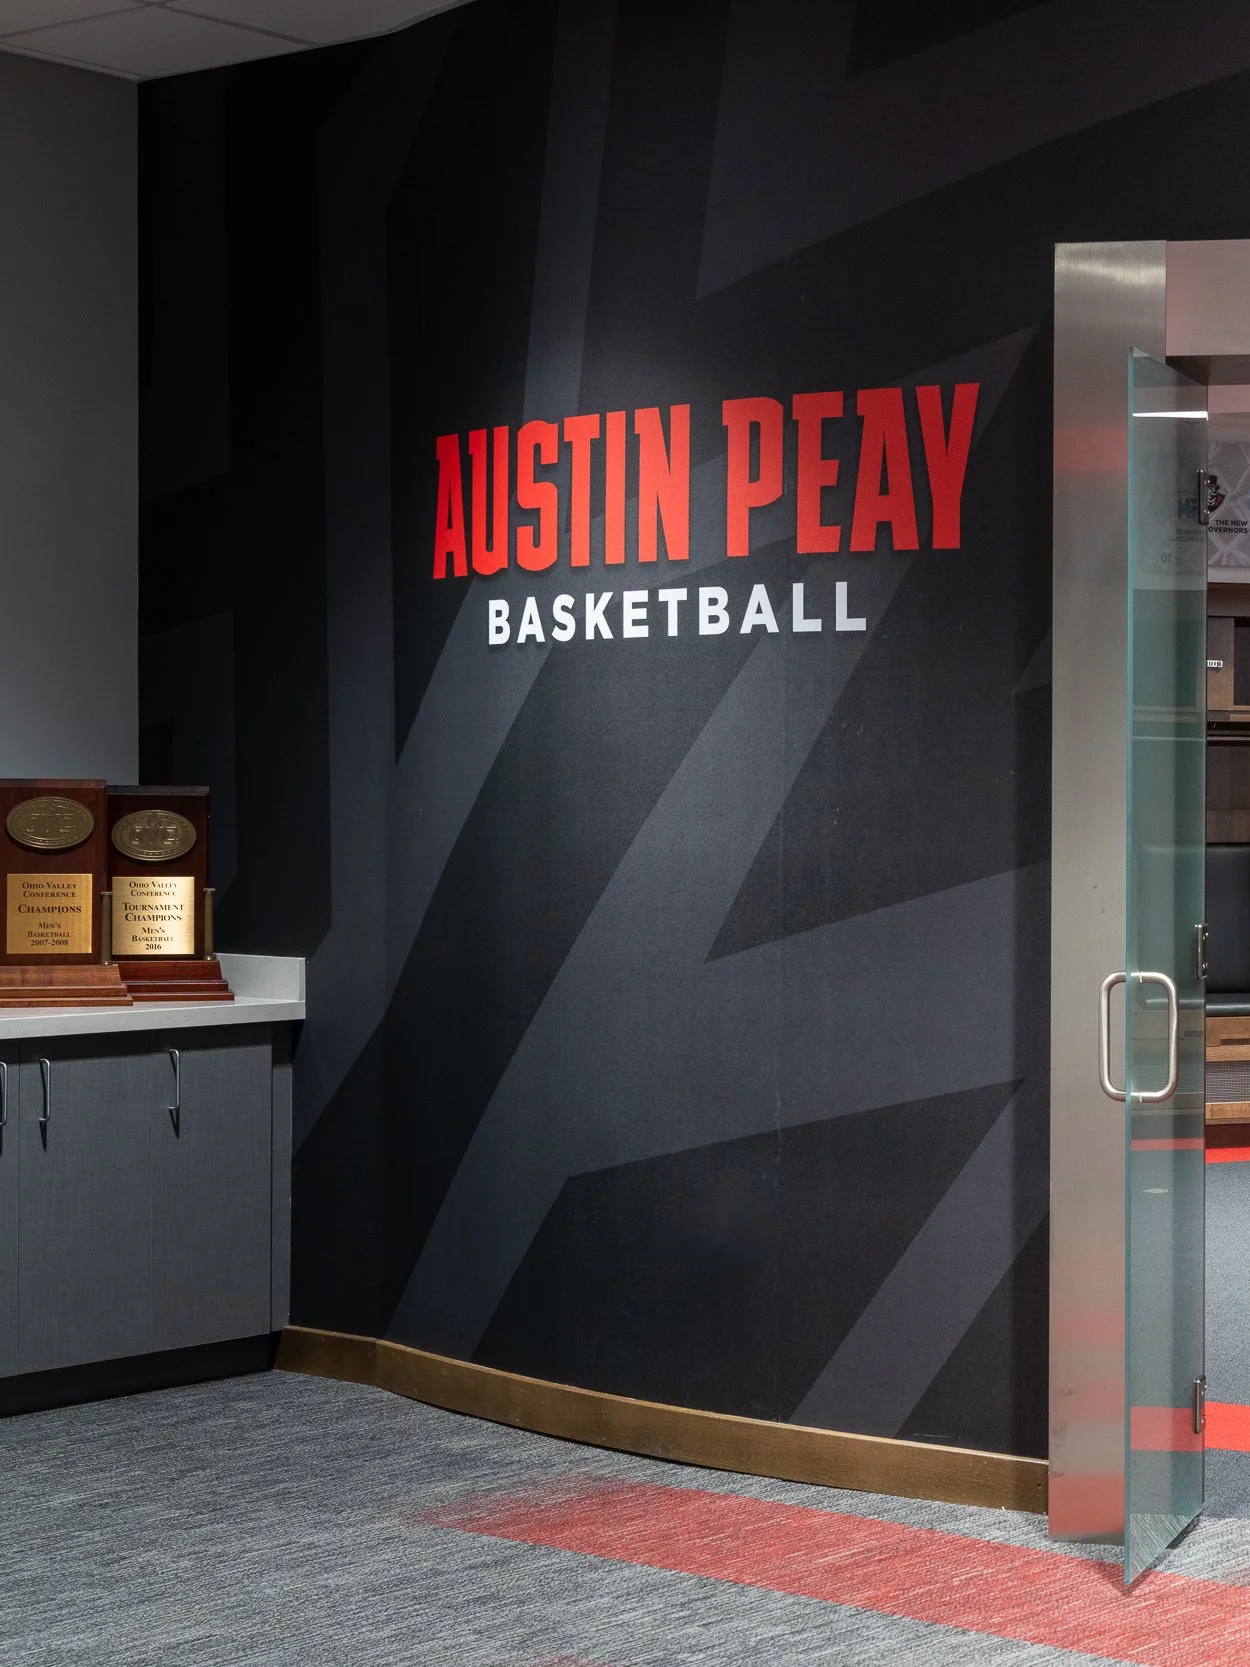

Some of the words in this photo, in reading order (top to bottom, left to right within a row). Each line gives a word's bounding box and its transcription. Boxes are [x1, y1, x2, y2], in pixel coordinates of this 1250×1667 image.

[433, 403, 690, 580] AUSTIN
[721, 382, 981, 557] PEAY
[1208, 526, 1248, 534] OVERNORS
[487, 581, 867, 646] BASKETBALL
[23, 890, 77, 898] CONFERENCE
[18, 904, 82, 913] CHAMPIONS
[122, 902, 184, 911] TOURNAMENT
[125, 912, 182, 922] CHAMPIONS
